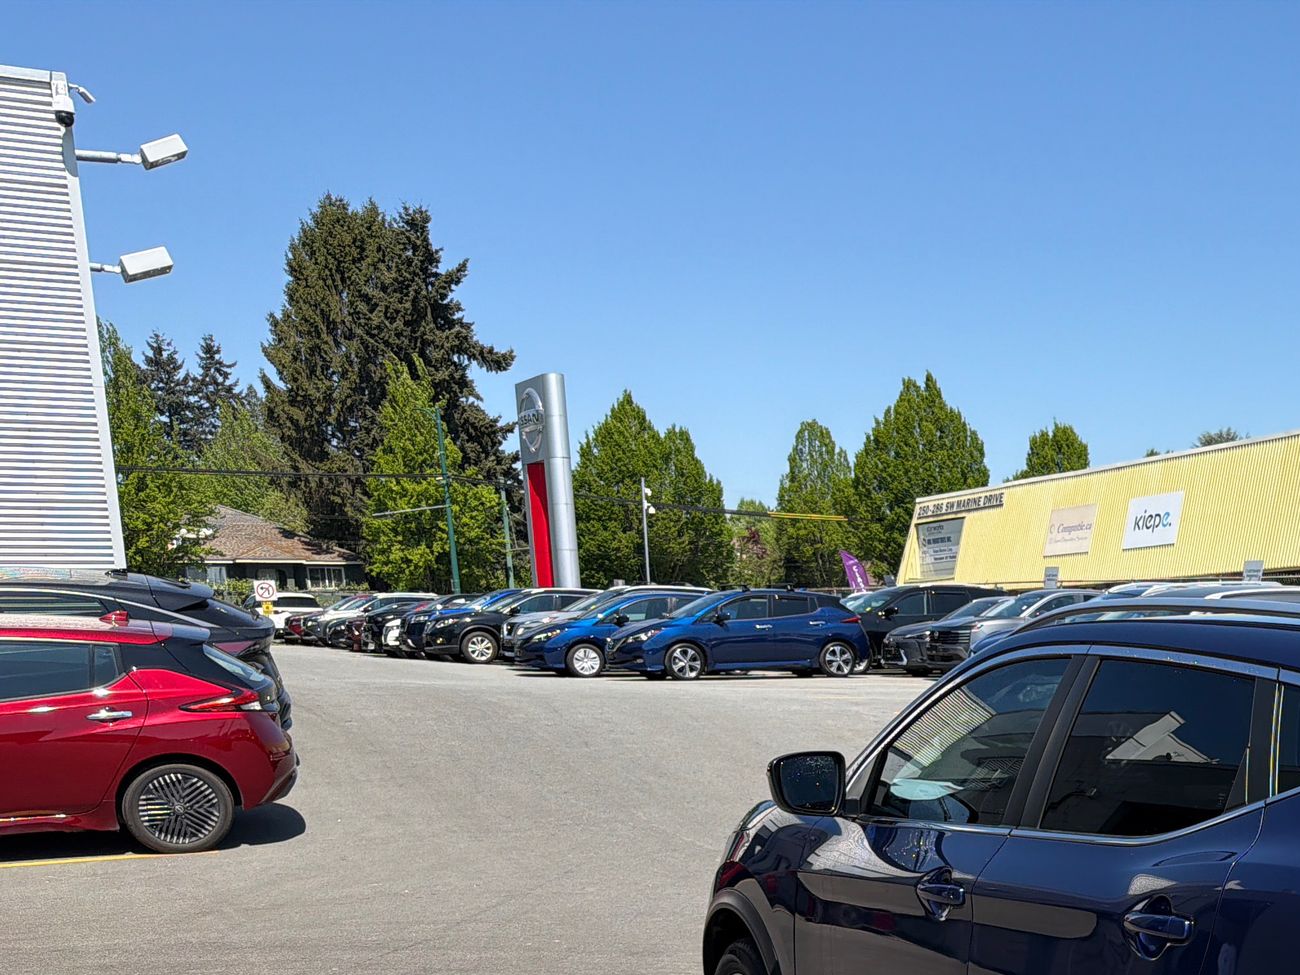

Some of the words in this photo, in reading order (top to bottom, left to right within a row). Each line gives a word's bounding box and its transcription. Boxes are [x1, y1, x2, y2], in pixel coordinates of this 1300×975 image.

[945, 501, 956, 512] SW
[956, 496, 983, 509] MARINE
[983, 492, 1004, 505] DRIVE
